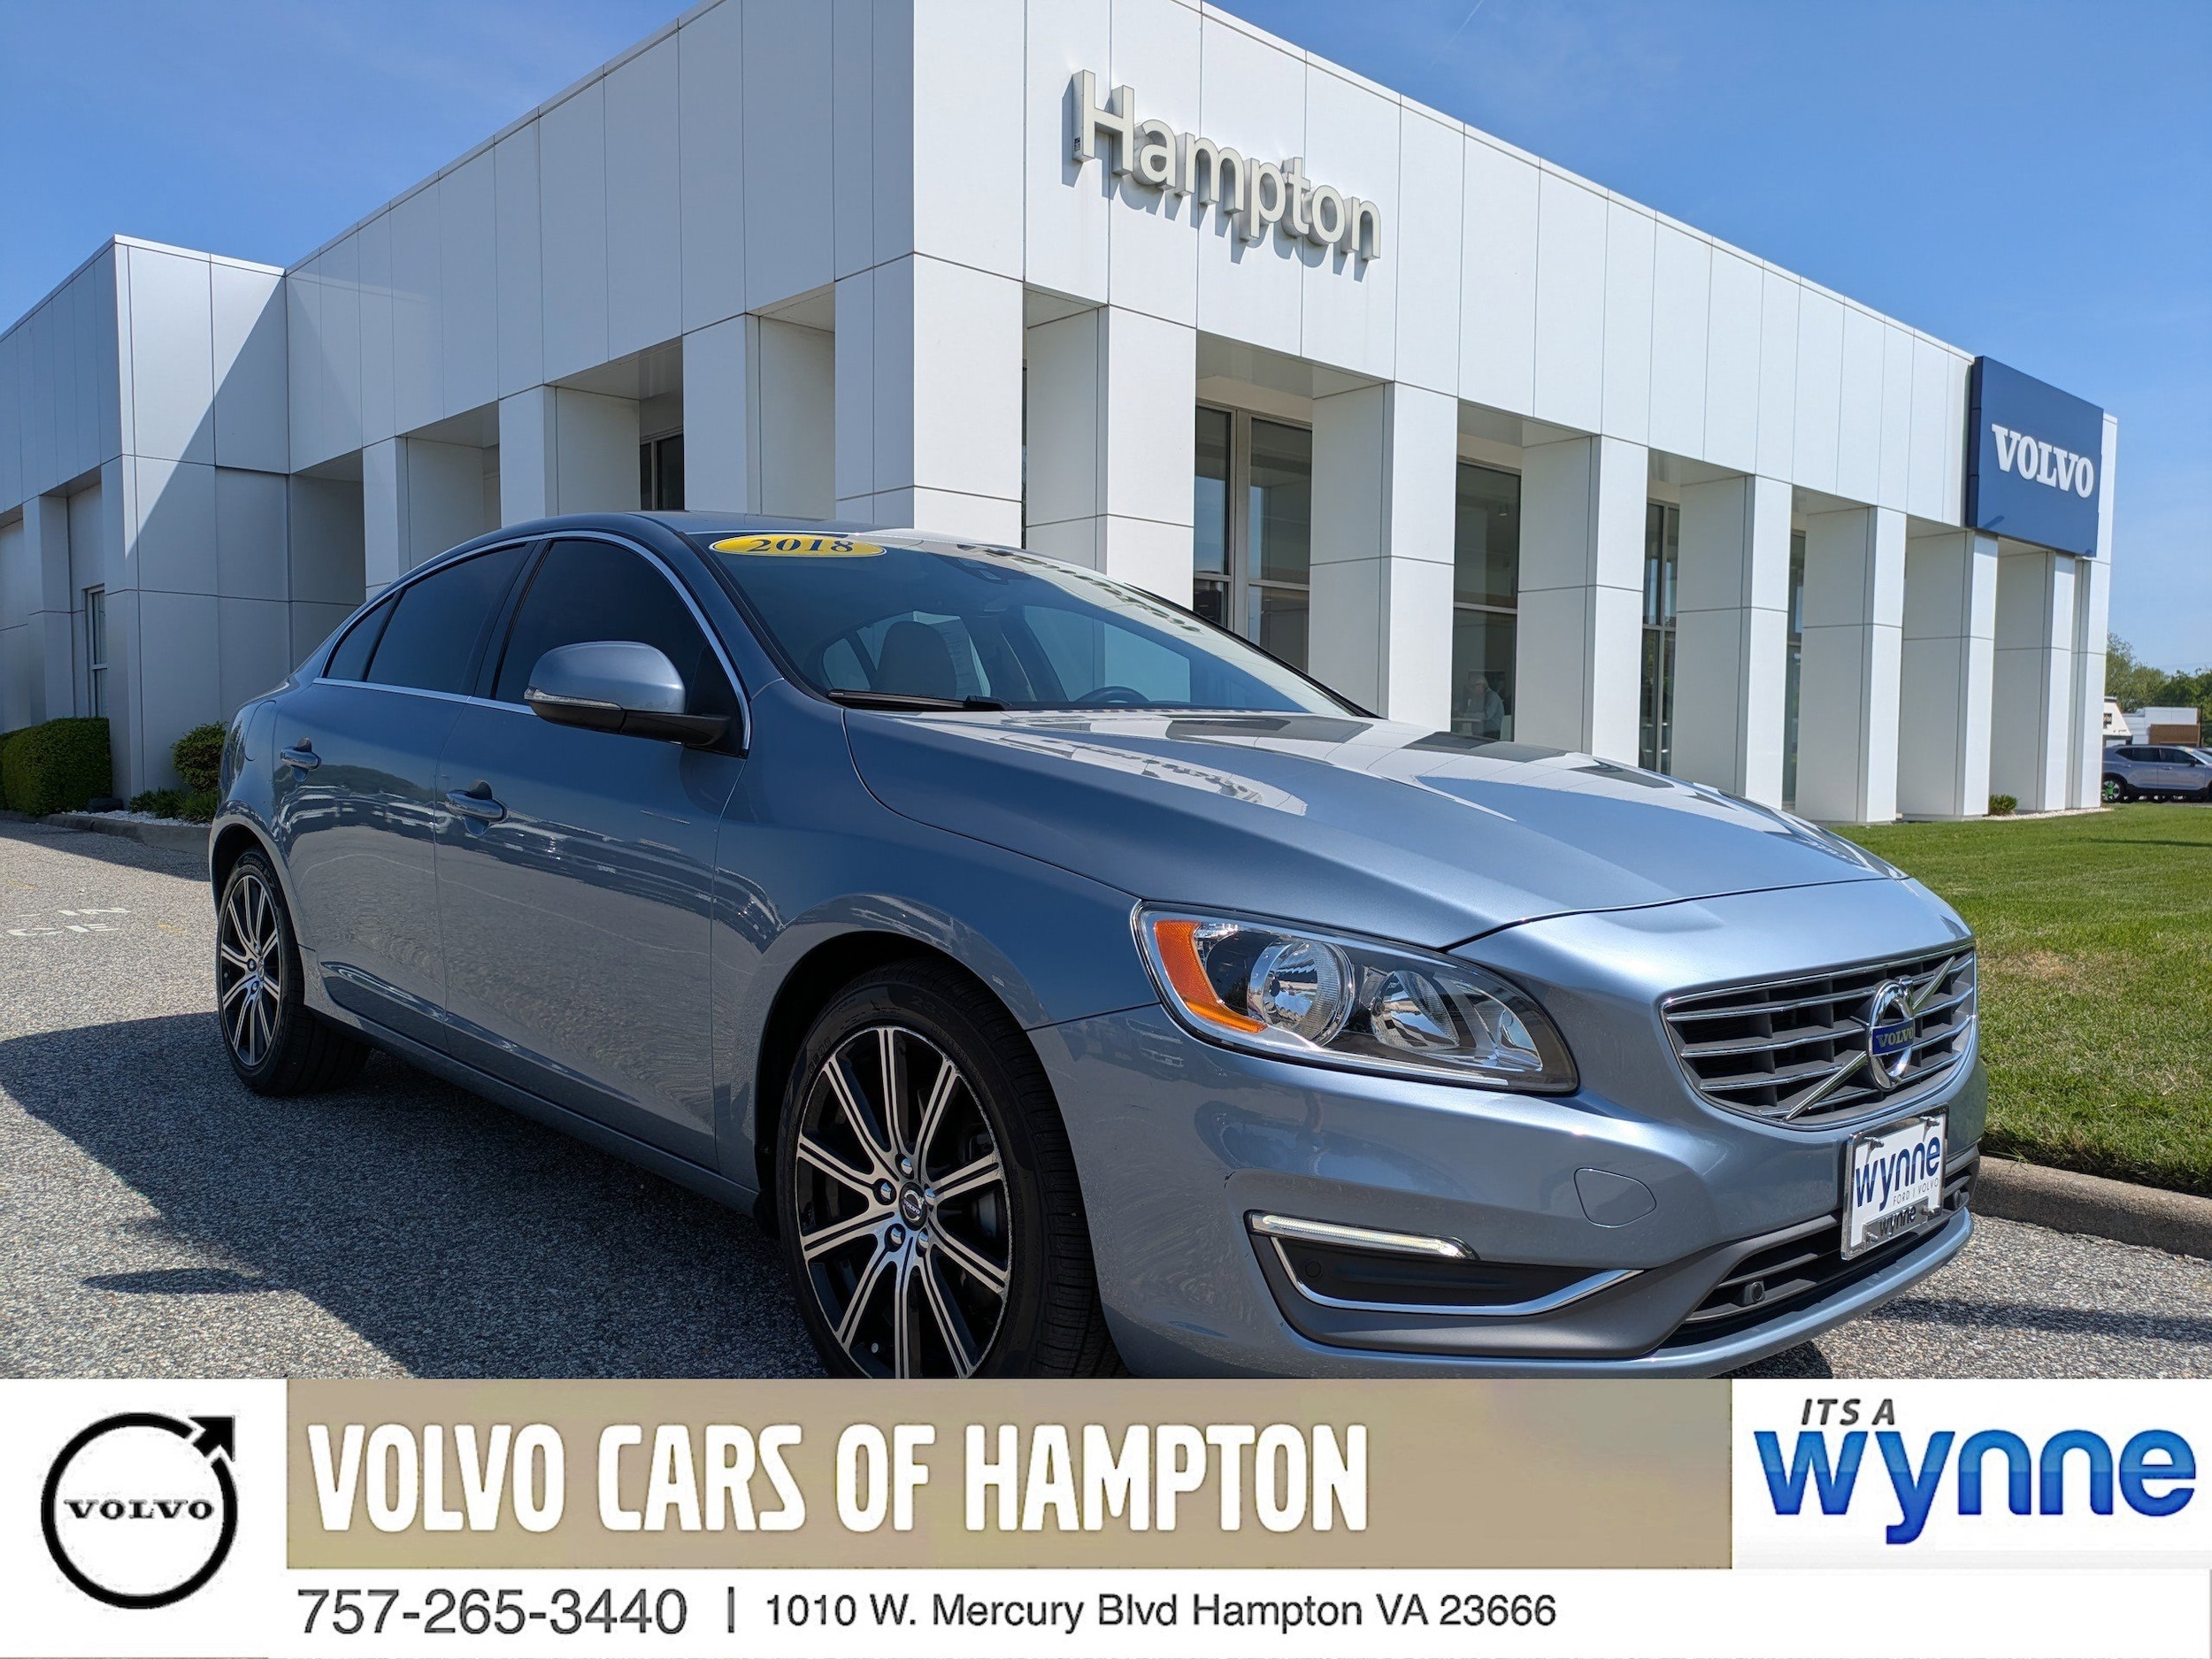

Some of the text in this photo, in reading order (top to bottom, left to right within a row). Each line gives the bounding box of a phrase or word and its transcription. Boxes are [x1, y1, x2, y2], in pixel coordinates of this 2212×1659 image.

[1072, 69, 1381, 261] Hampton
[1991, 423, 2094, 498] VOLVO
[747, 538, 855, 552] 2018
[1876, 1026, 1914, 1048] VOLVO
[1856, 1137, 1940, 1212] wynne
[1893, 1178, 1939, 1206] FORD VOLVO
[1879, 1205, 1916, 1239] wynne
